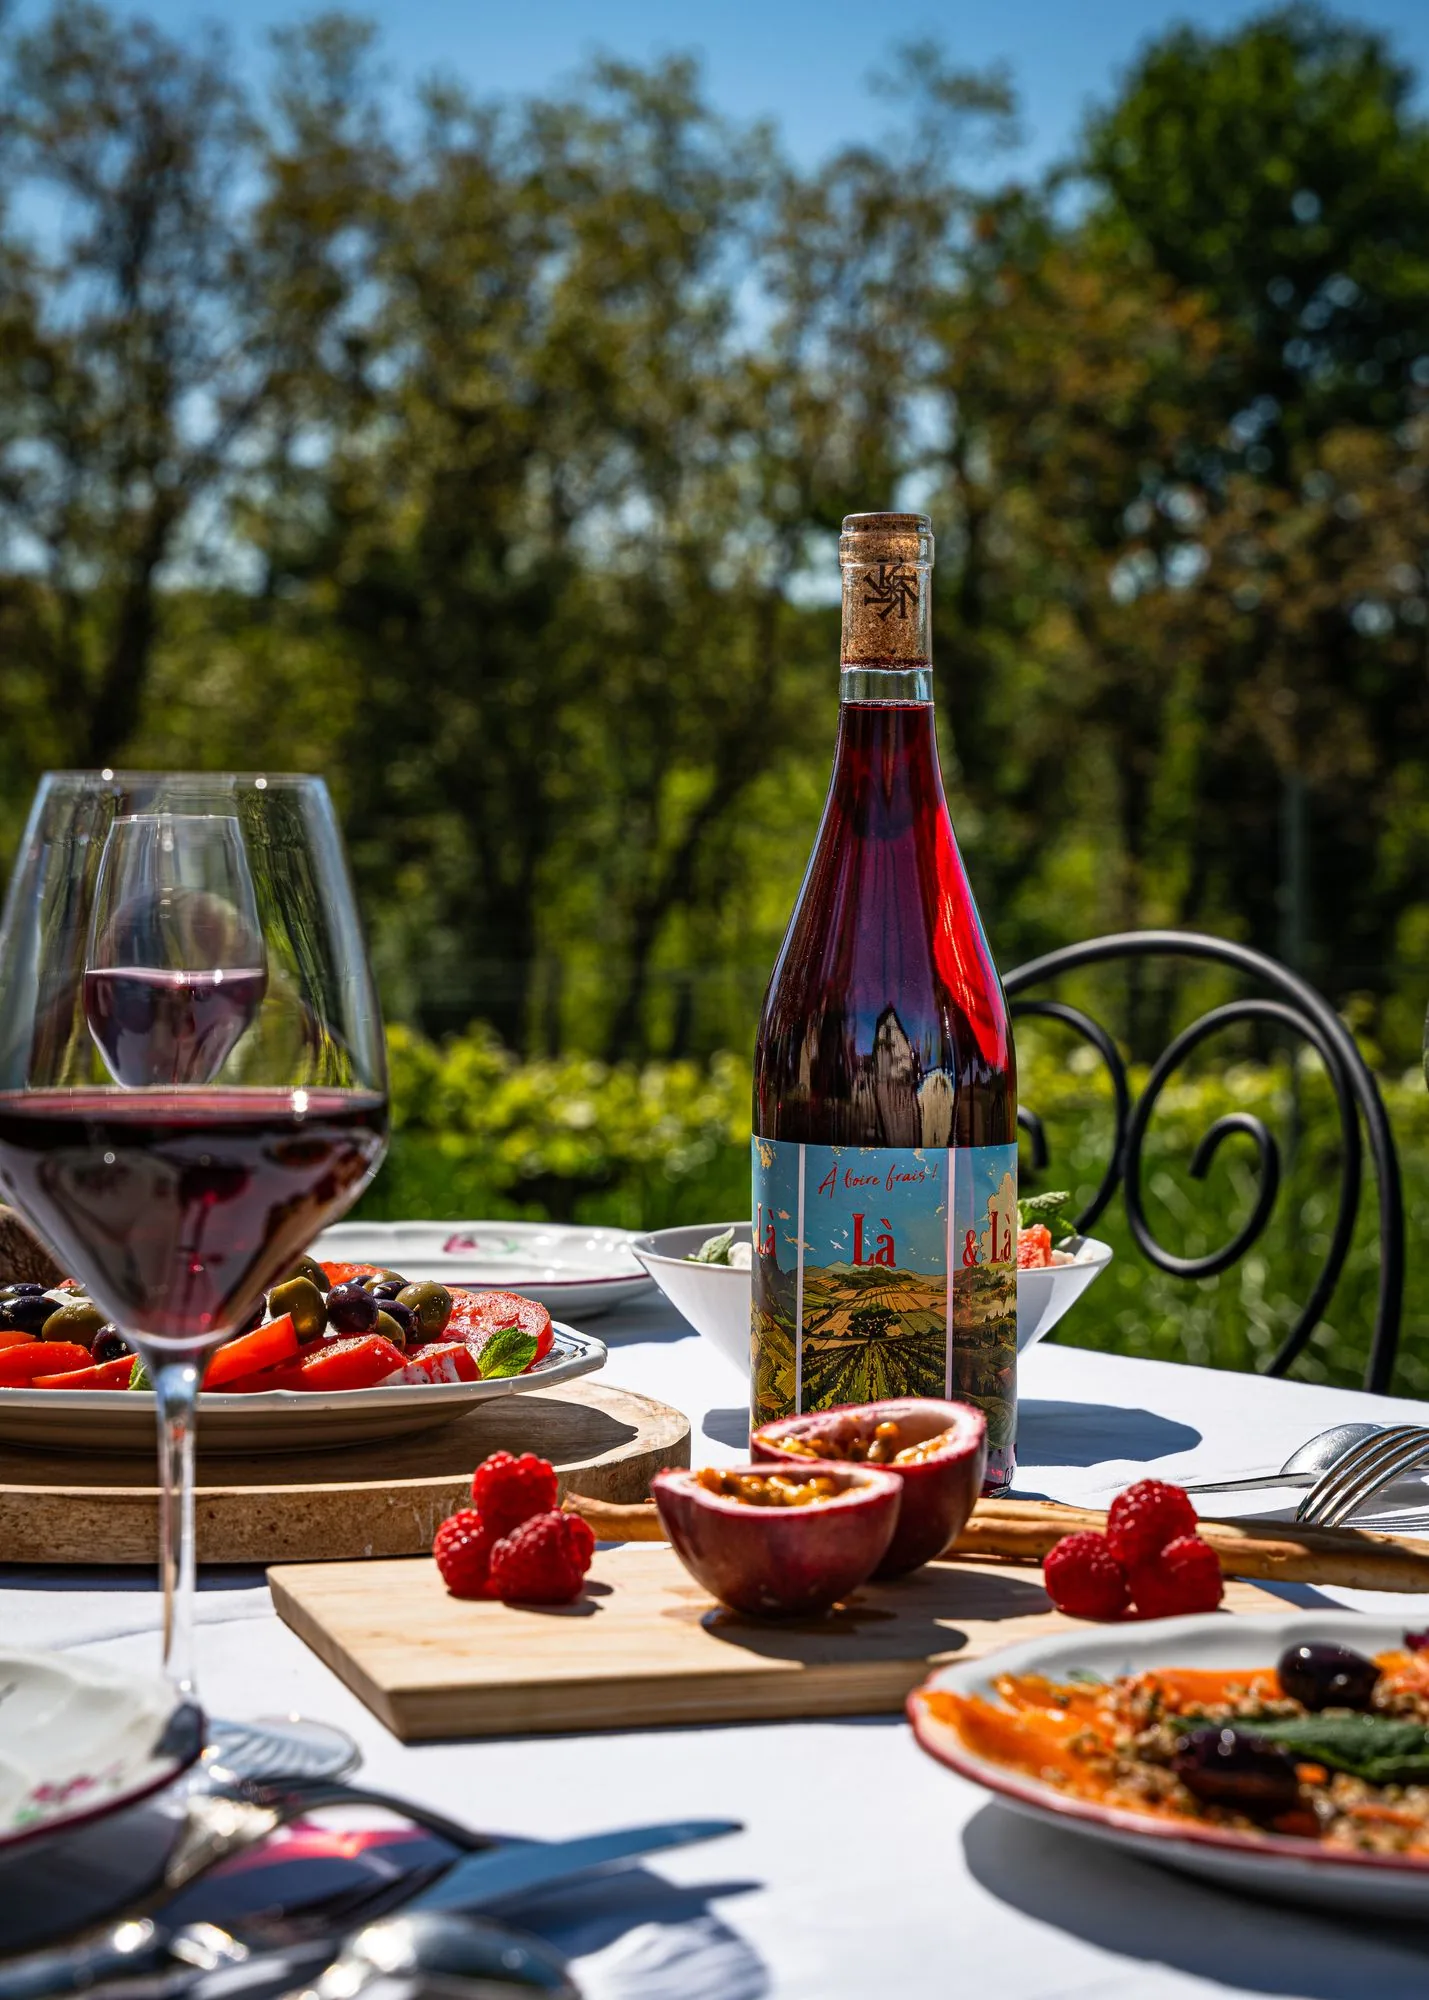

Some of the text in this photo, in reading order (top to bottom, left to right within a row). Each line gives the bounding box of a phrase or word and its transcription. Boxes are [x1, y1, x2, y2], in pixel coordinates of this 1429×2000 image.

[818, 1161, 839, 1199] À
[842, 1167, 881, 1189] boire
[852, 1213, 897, 1268] Là
[962, 1229, 980, 1267] &
[987, 1210, 1012, 1265] Là
